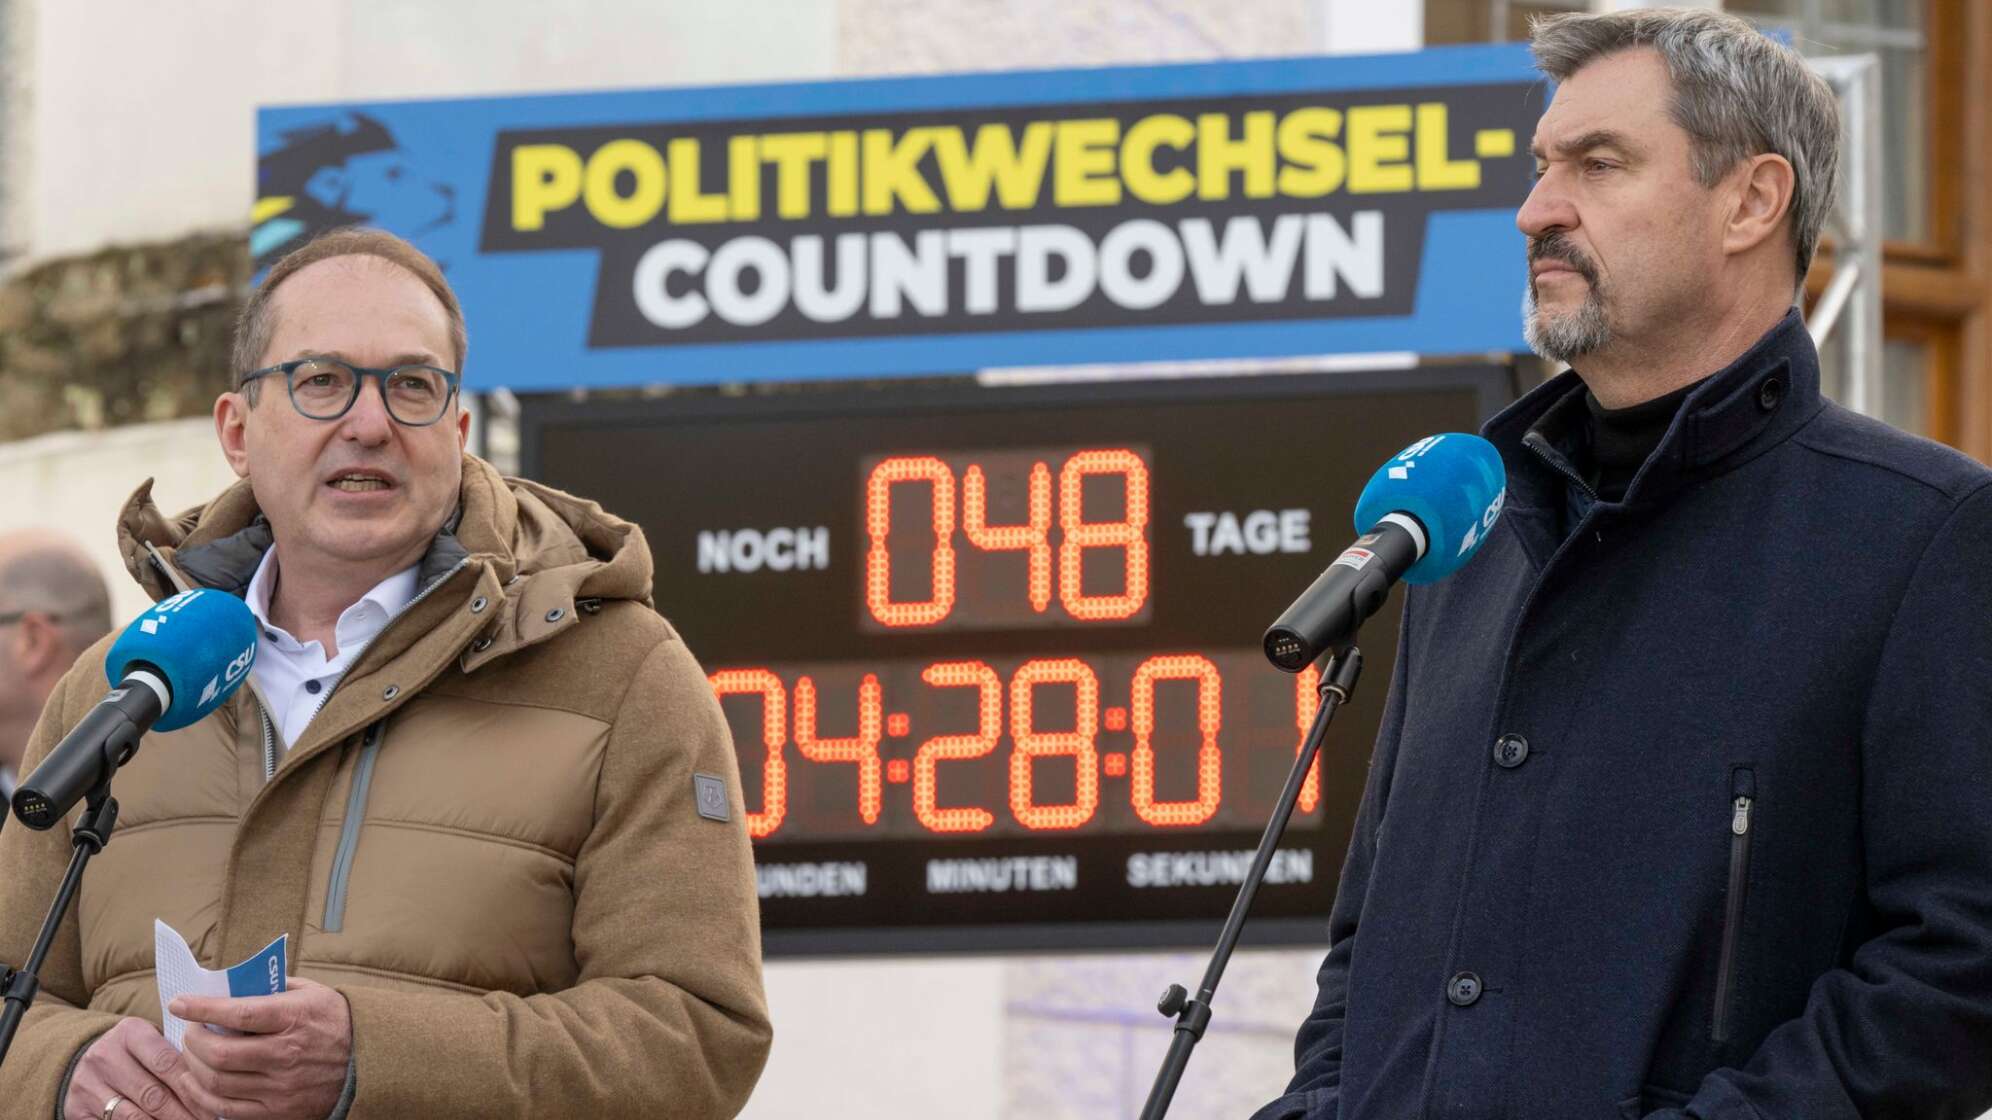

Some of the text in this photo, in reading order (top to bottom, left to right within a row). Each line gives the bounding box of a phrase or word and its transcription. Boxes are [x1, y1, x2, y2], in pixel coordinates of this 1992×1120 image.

[509, 103, 1515, 231] POLITIKWECHSEL-
[632, 210, 1384, 329] COUNTDOWN
[698, 449, 1310, 627] NOCH 048 TAGE
[225, 641, 255, 681] CSU
[926, 856, 1076, 893] MINUTEN
